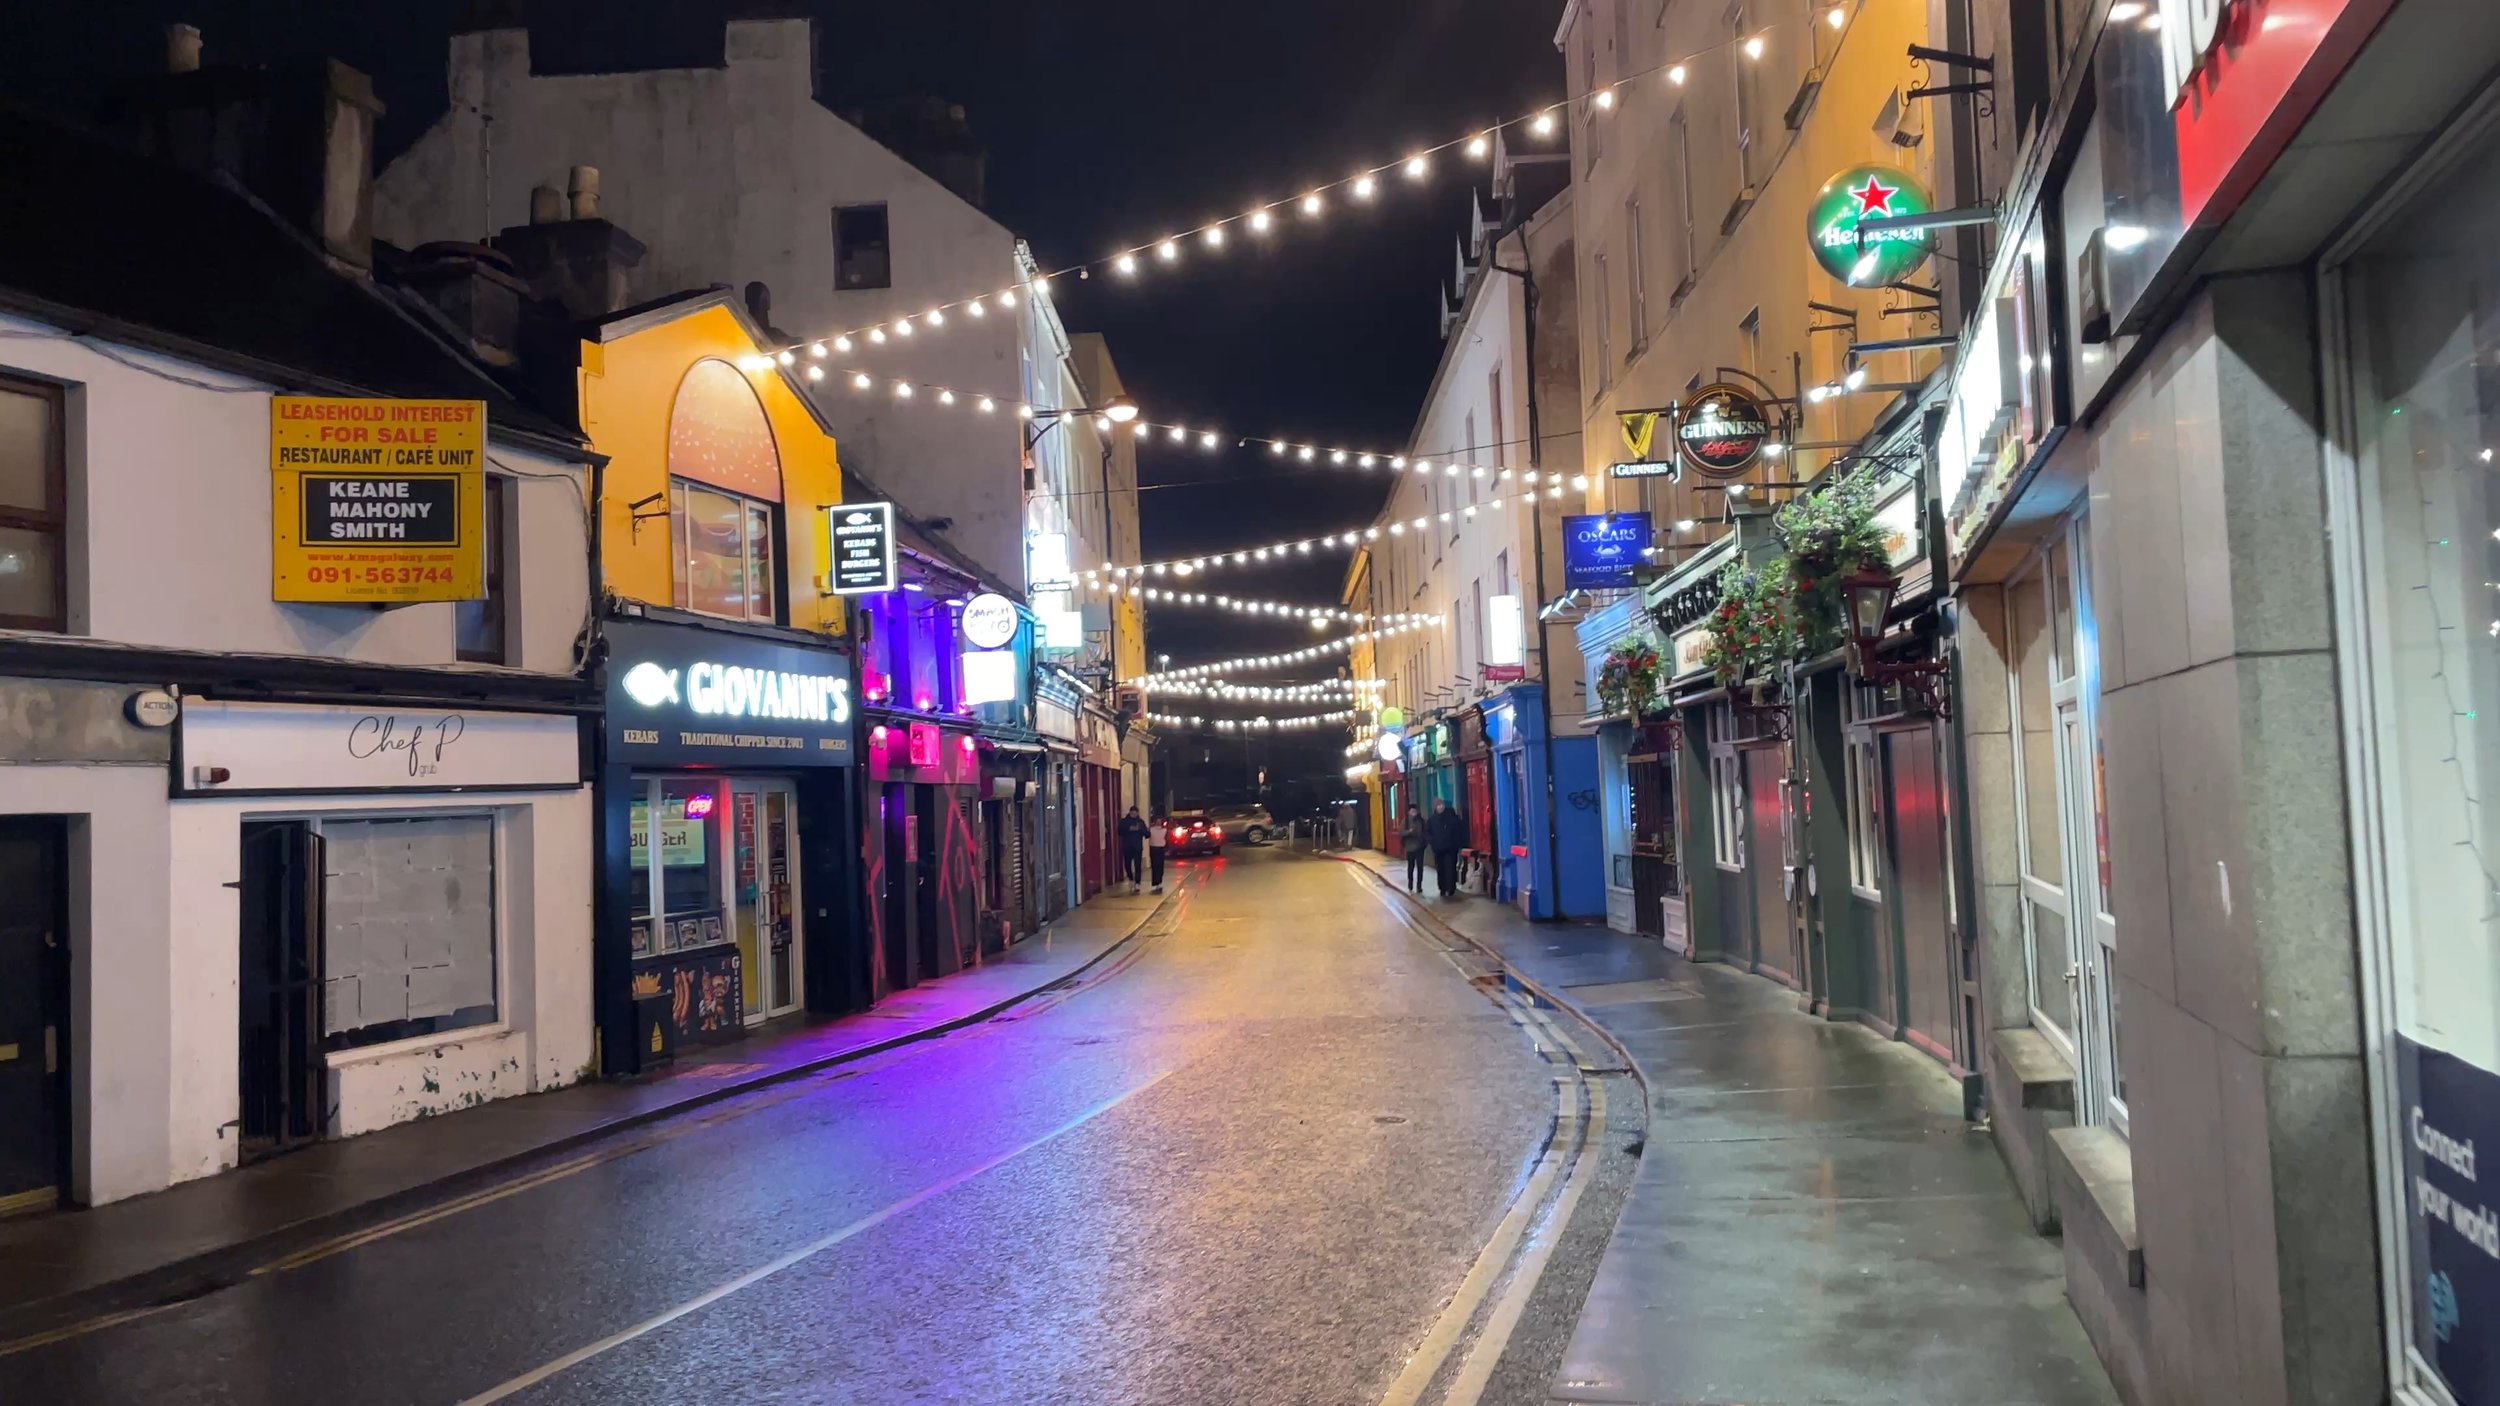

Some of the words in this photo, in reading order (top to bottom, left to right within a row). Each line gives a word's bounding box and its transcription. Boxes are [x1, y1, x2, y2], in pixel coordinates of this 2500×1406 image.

[280, 404, 385, 421] LEASEHOLD
[391, 406, 475, 422] INTEREST
[320, 427, 369, 443] FOR
[377, 428, 438, 443] SALE
[1680, 420, 1767, 439] GUINNESS
[280, 448, 382, 465] RESTAURANT
[438, 450, 474, 465] UNIT
[1616, 463, 1667, 476] GUINNESS
[329, 482, 410, 497] KEANE
[329, 502, 432, 517] MAHONY
[330, 523, 405, 538] SMITH
[1578, 528, 1636, 543] OSCARS
[843, 538, 877, 549] KEBABS
[850, 549, 870, 558] FISH
[841, 558, 880, 569] BURGERS
[1574, 564, 1612, 573] SEAFOOD
[307, 567, 454, 583] 091-563744
[686, 661, 849, 723] GIOVANNI'S
[143, 701, 174, 711] ACTION
[623, 729, 659, 744] KEBABS
[680, 732, 734, 747] TRADITIONAL
[735, 734, 767, 748] CHIPPER
[767, 736, 787, 749] SINCE
[348, 715, 422, 777] Chef
[435, 714, 465, 762] P
[687, 799, 713, 814] OPEN
[630, 831, 687, 847] BUGER
[2411, 1105, 2477, 1182] Connect
[2416, 1175, 2450, 1224] your
[2450, 1203, 2500, 1260] world
